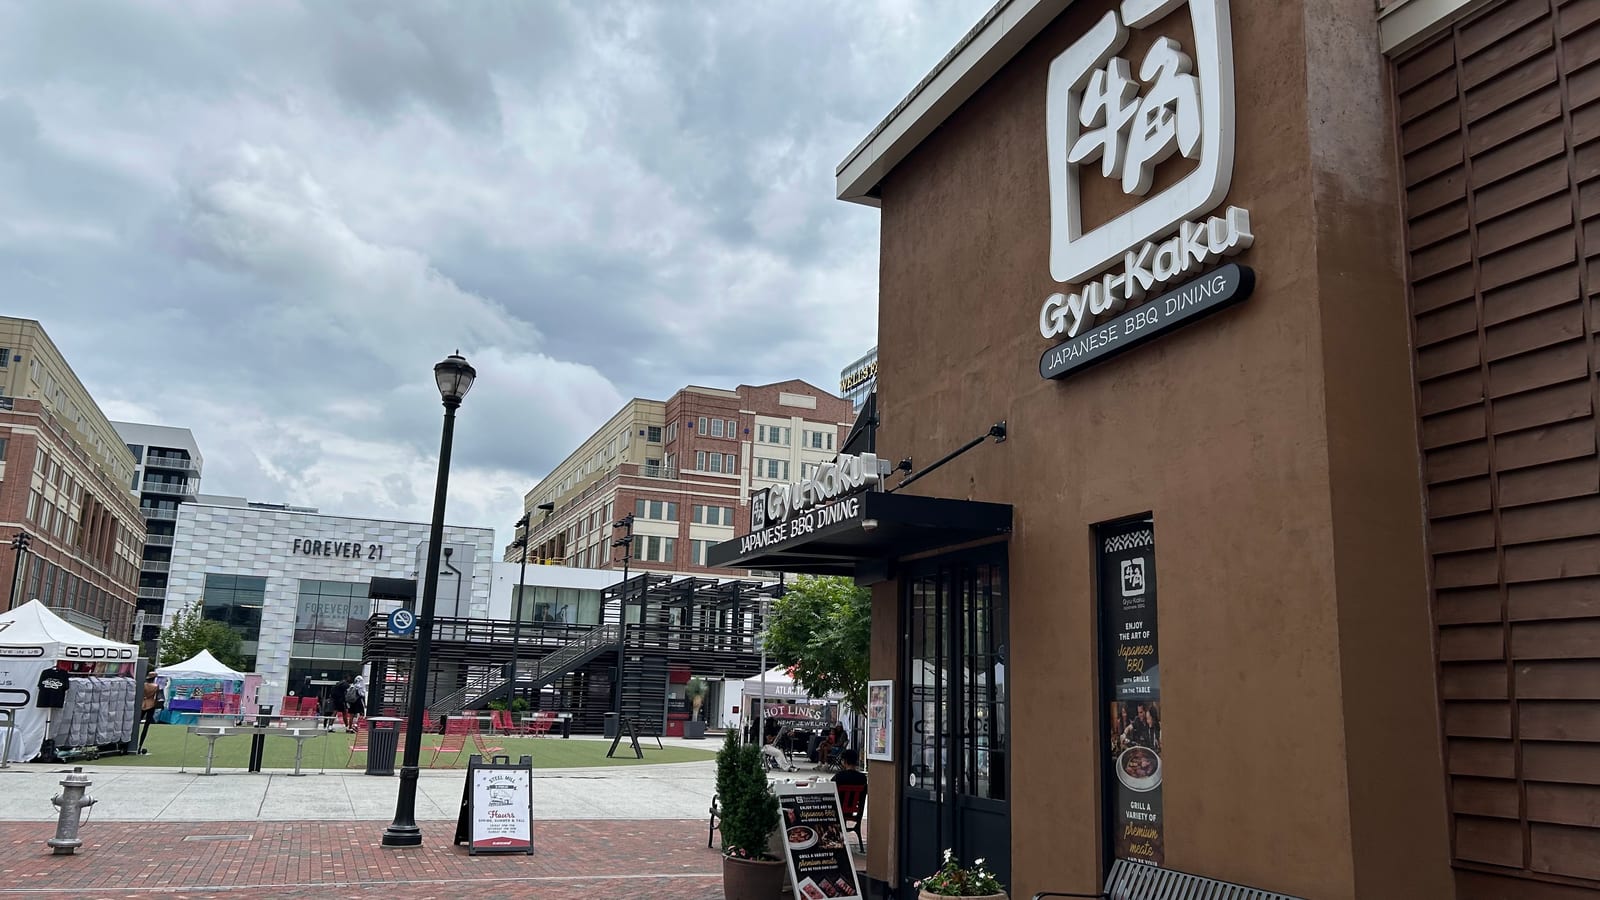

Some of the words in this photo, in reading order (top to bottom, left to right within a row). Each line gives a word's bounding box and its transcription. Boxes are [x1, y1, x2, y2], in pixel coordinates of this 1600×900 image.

[1067, 36, 1204, 197] 牛角
[1039, 206, 1254, 339] Gyu-Kaku
[1048, 325, 1119, 370] JAPANESE
[1124, 307, 1158, 335] BBQ
[1165, 275, 1227, 315] DINING
[767, 452, 879, 522] Gyu-Kaku
[740, 523, 787, 554] JAPANESE
[790, 514, 814, 537] BBQ
[817, 498, 860, 529] DINING
[293, 539, 361, 558] FOREVER
[368, 545, 383, 560] 21
[305, 602, 348, 614] FOREVER
[353, 605, 364, 615] 21
[1125, 621, 1143, 630] ENJOY
[1131, 631, 1142, 639] ART
[1143, 630, 1150, 638] OF
[1118, 644, 1154, 661] Japanese
[1126, 658, 1144, 673] BBQ
[1133, 675, 1149, 683] GRILLS
[764, 705, 785, 718] HOT
[788, 705, 822, 720] LINKS
[1130, 801, 1146, 810] GRILL
[488, 810, 515, 818] Hours
[1126, 811, 1148, 820] VARIETY
[1148, 813, 1156, 822] OF
[1124, 822, 1158, 839] premium
[1130, 841, 1154, 856] meats
